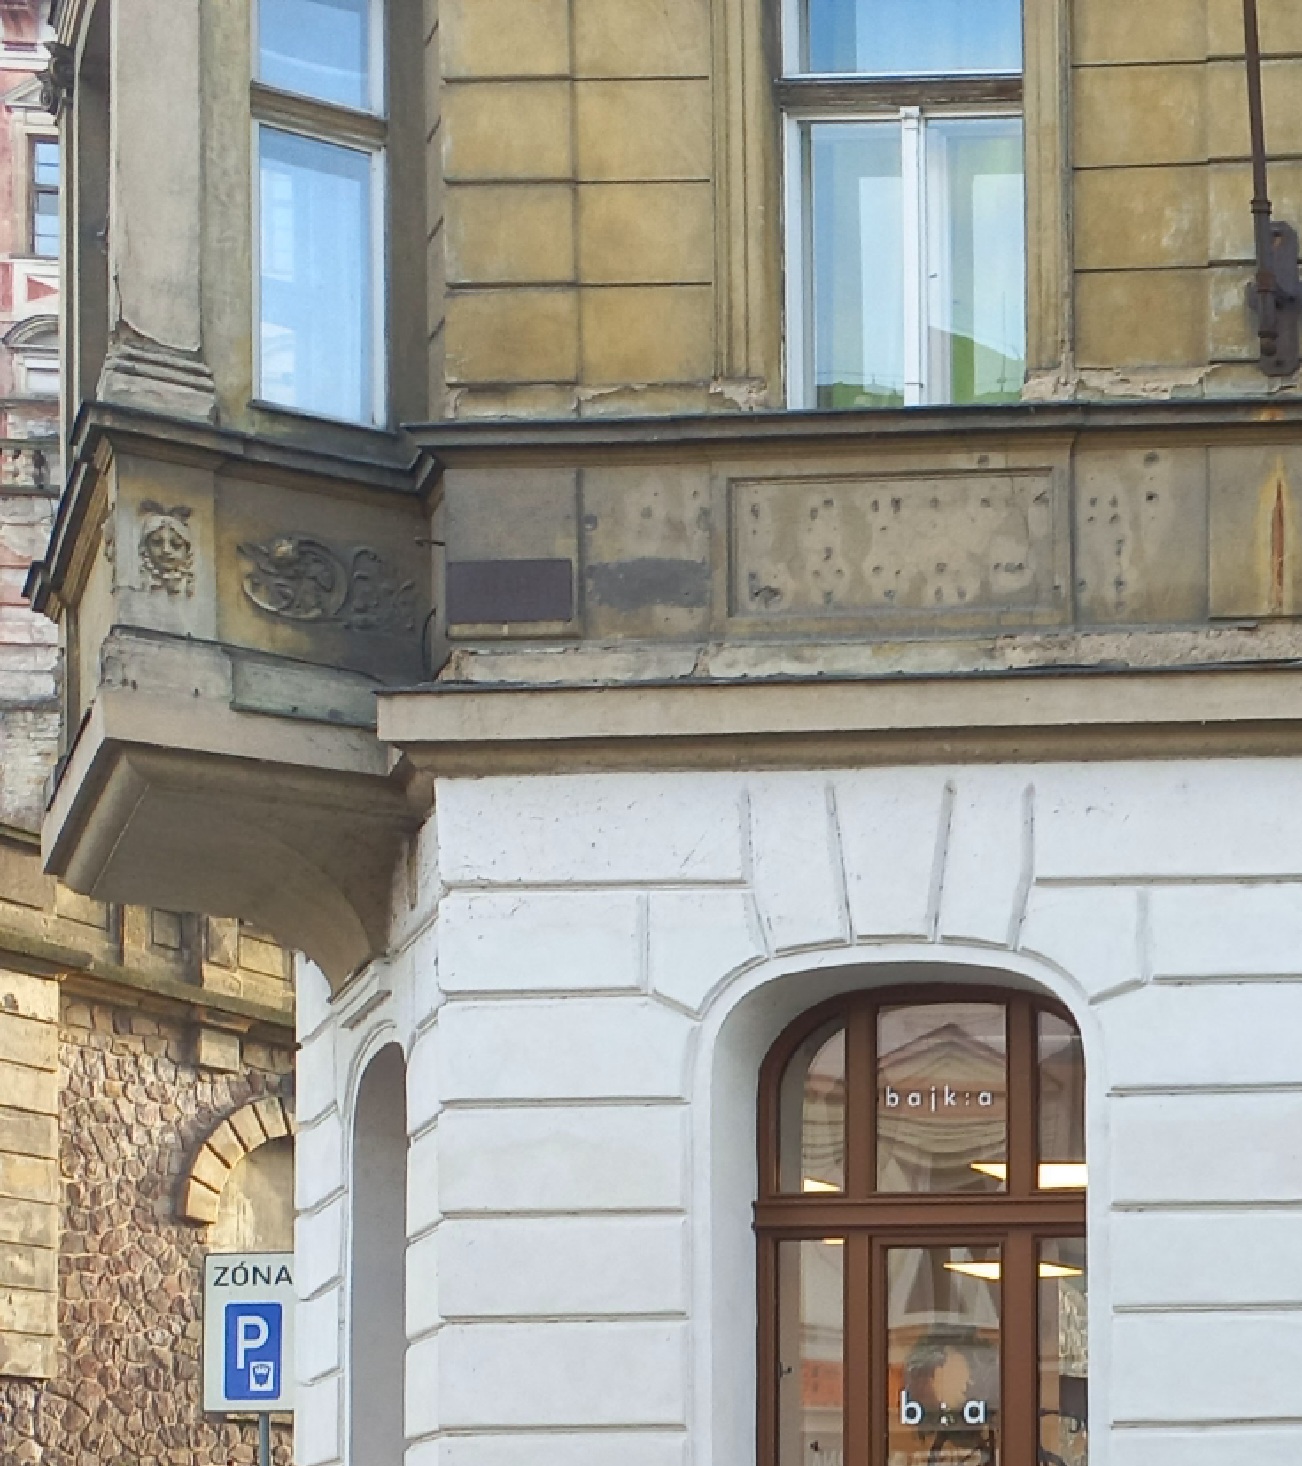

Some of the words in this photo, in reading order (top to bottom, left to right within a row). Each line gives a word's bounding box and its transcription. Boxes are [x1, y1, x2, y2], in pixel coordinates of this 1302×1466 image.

[884, 1083, 993, 1112] bajk:a
[212, 1260, 293, 1287] ZÓNA
[235, 1314, 270, 1370] P
